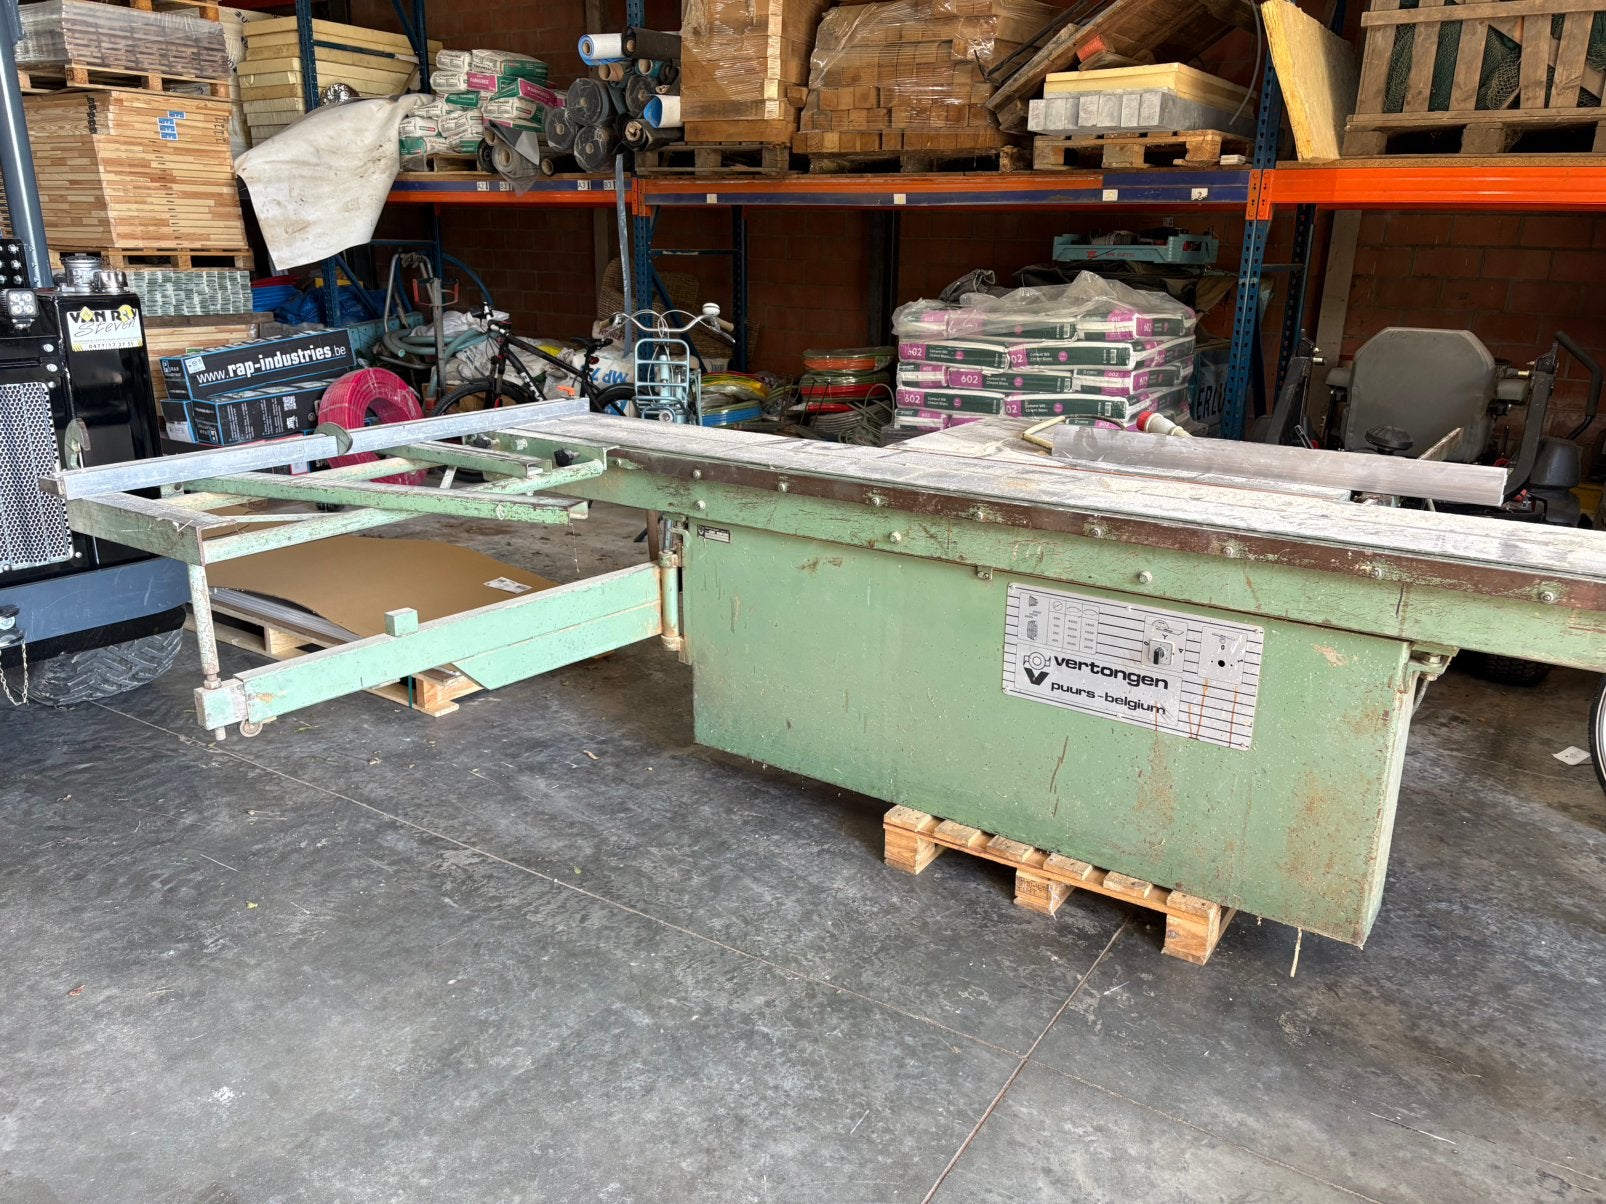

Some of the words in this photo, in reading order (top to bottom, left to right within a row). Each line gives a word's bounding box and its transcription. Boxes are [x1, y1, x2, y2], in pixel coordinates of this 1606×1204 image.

[578, 181, 586, 189] A3
[69, 310, 107, 323] VAN
[74, 319, 136, 337] Steven
[197, 345, 347, 384] www.rap-industries.be
[1011, 354, 1024, 364] 02
[602, 369, 629, 384] MP
[961, 374, 979, 384] 602
[904, 394, 921, 404] 602
[1196, 383, 1227, 420] ERLU
[1006, 405, 1018, 414] 02
[1054, 656, 1169, 690] vertongen
